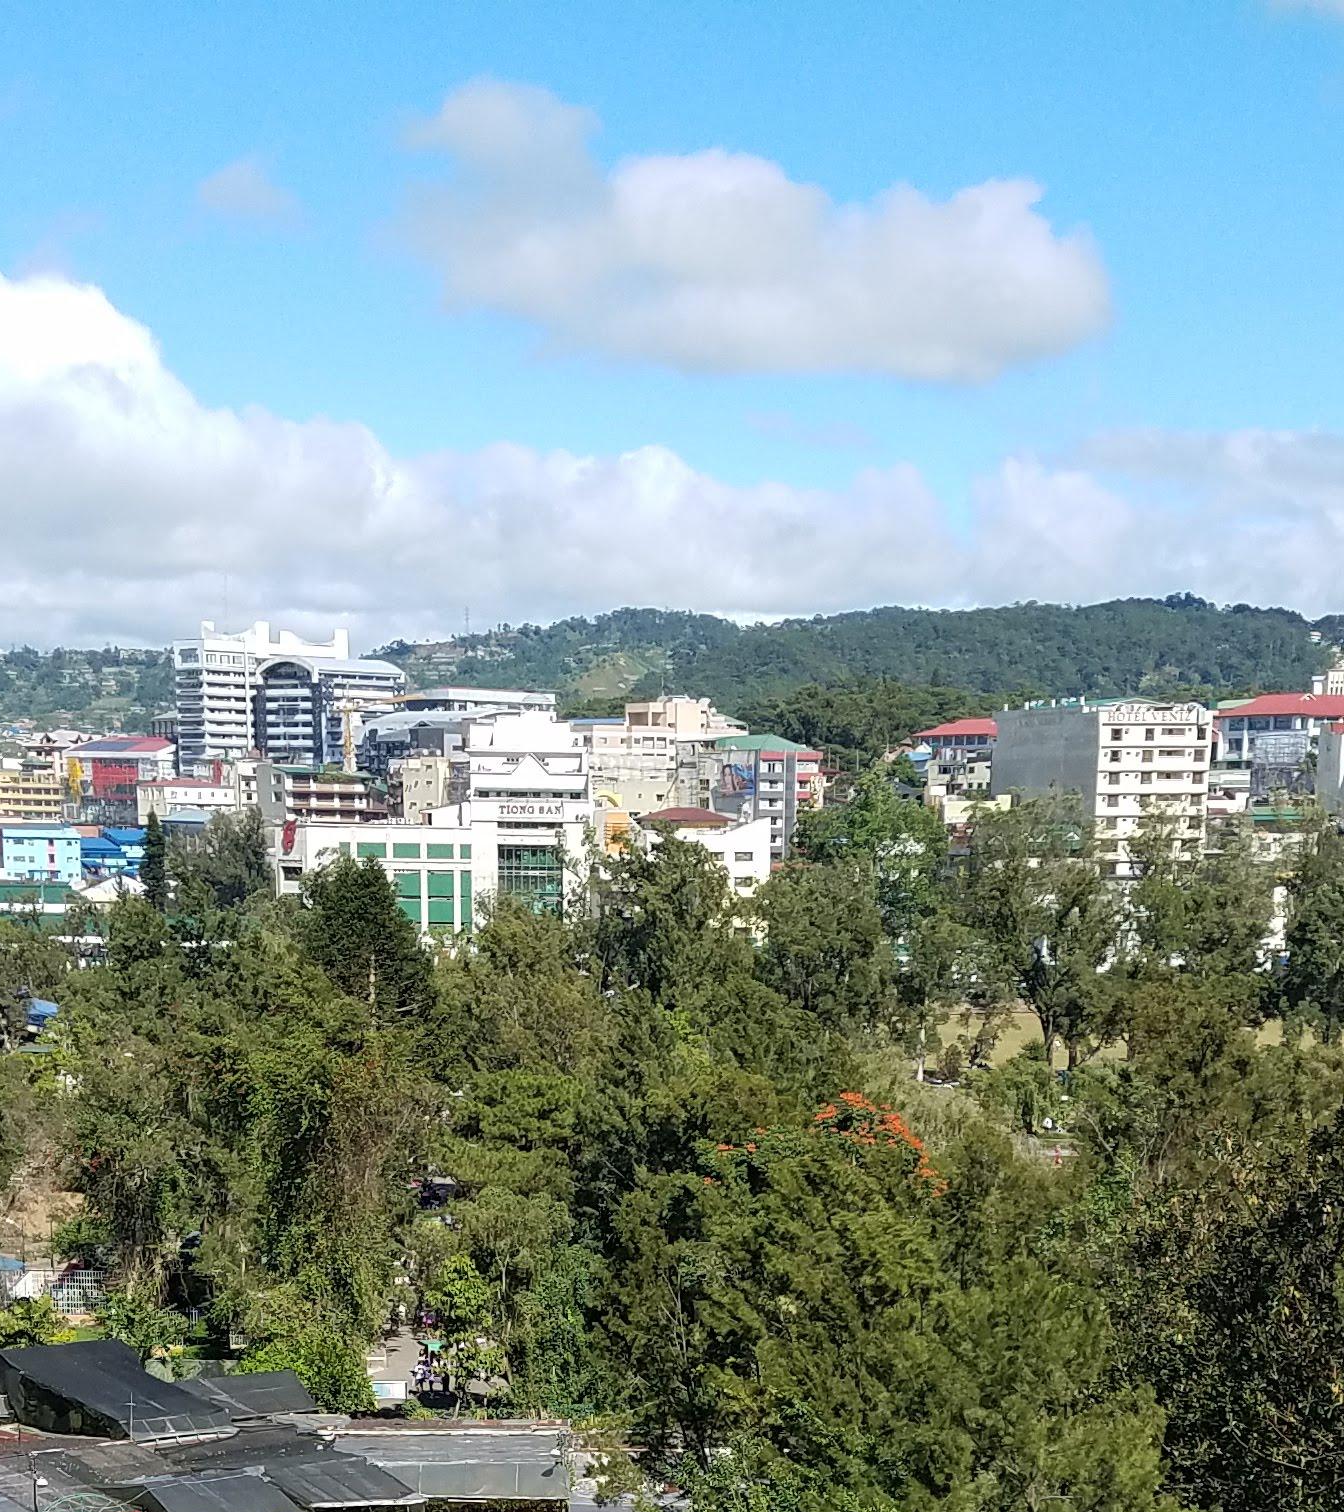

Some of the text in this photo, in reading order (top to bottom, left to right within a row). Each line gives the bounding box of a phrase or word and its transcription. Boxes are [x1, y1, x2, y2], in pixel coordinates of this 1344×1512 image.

[1107, 711, 1191, 722] HOTEL VENIZ
[498, 804, 562, 815] TIONG SAN
